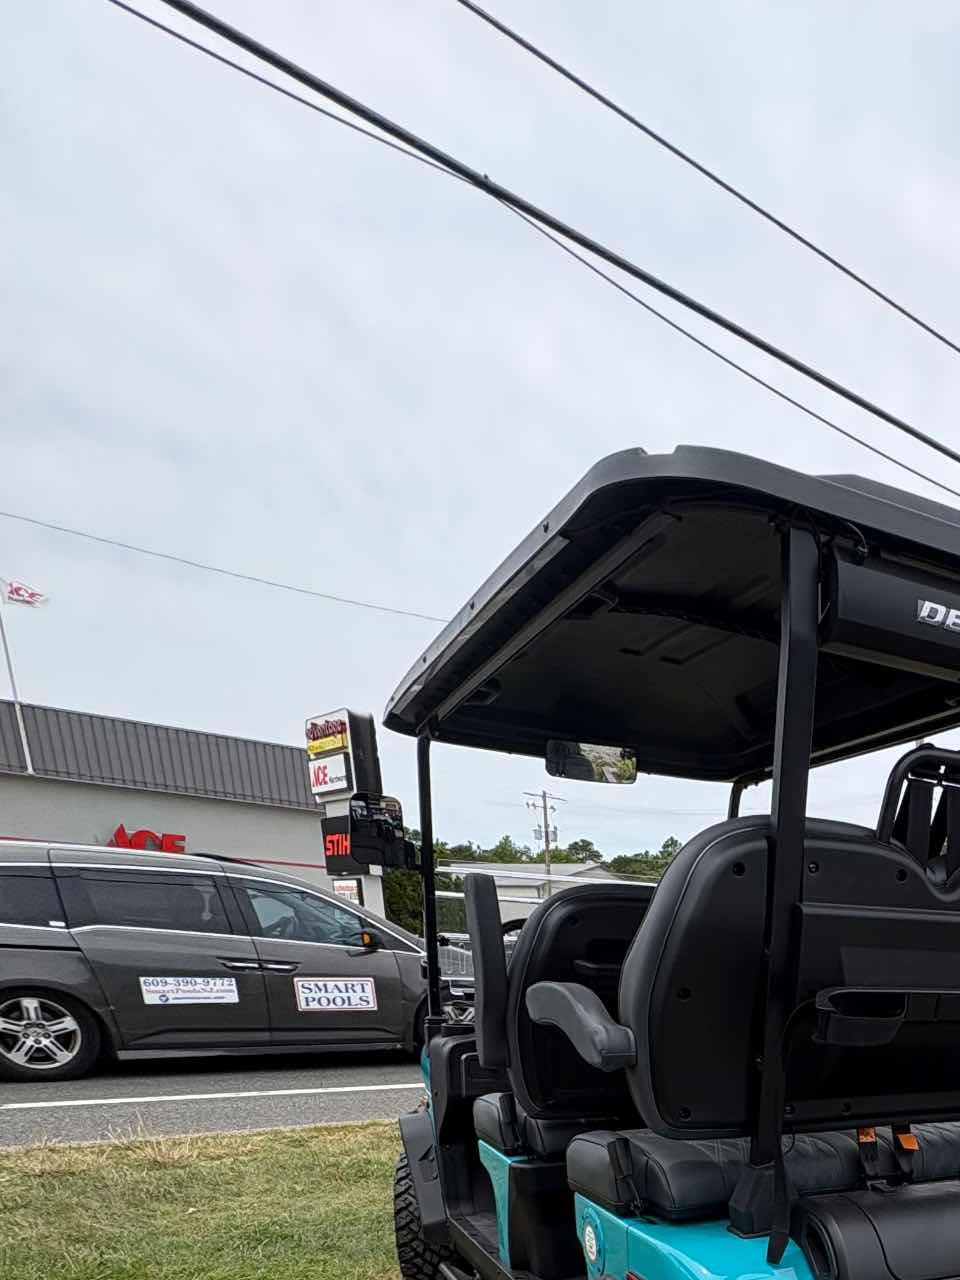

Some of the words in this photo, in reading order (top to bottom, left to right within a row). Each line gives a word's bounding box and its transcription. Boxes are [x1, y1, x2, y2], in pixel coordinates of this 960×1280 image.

[312, 765, 328, 788] ACE
[325, 833, 351, 856] STIH
[301, 983, 368, 994] SMART
[304, 996, 370, 1006] POOLS
